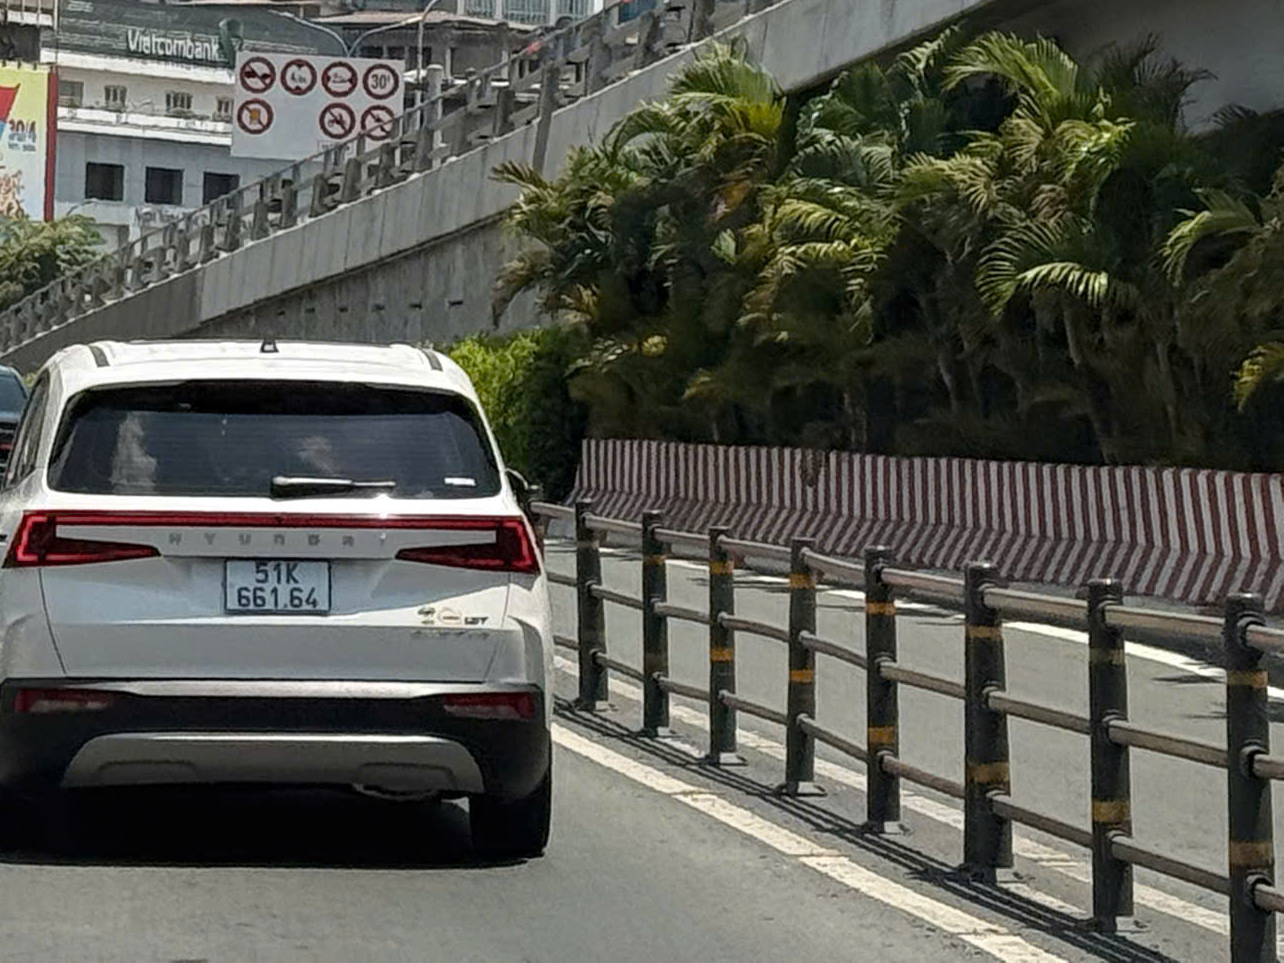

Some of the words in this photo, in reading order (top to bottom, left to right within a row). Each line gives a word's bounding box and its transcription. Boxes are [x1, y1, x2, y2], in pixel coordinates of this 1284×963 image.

[127, 28, 220, 61] Vietcombank
[168, 532, 387, 547] HYUNDAI
[255, 563, 299, 585] 51K
[237, 587, 319, 609] 661.64
